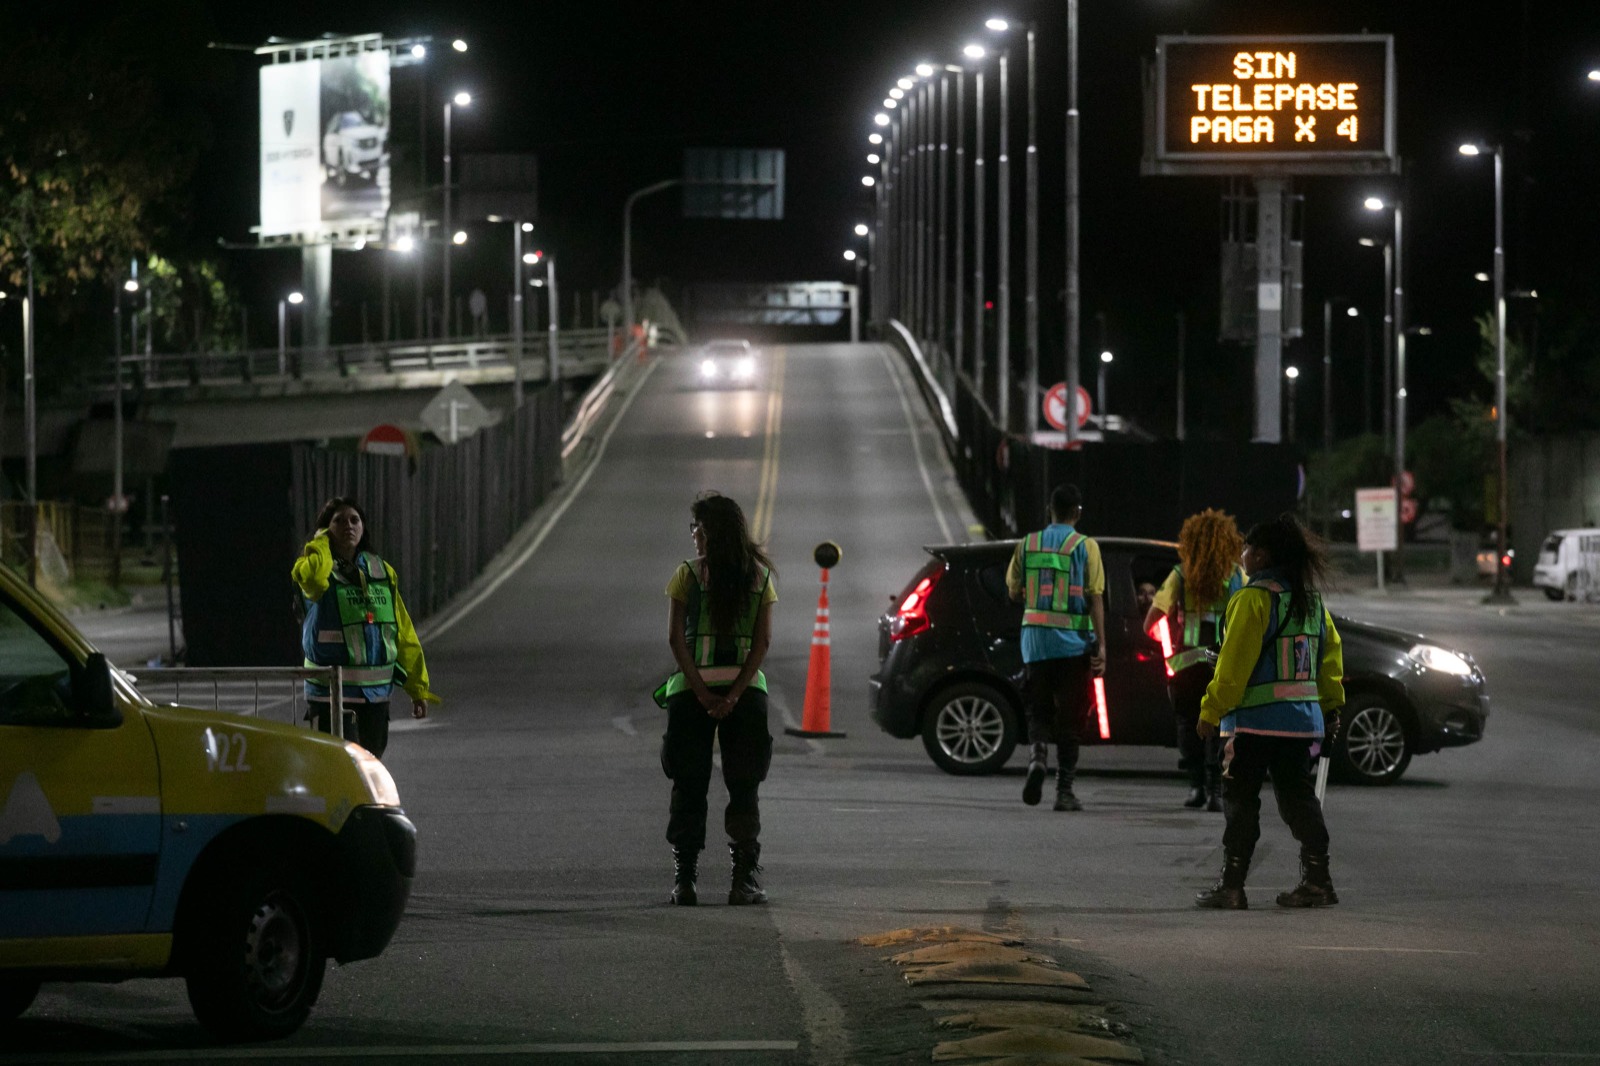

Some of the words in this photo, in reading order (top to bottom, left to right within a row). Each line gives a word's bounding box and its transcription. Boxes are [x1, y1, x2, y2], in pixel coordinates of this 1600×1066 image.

[1233, 51, 1296, 79] SIN
[1191, 83, 1358, 111] TELEPASE
[1190, 115, 1275, 143] PAGA
[1294, 115, 1316, 142] X
[1336, 114, 1358, 142] 4
